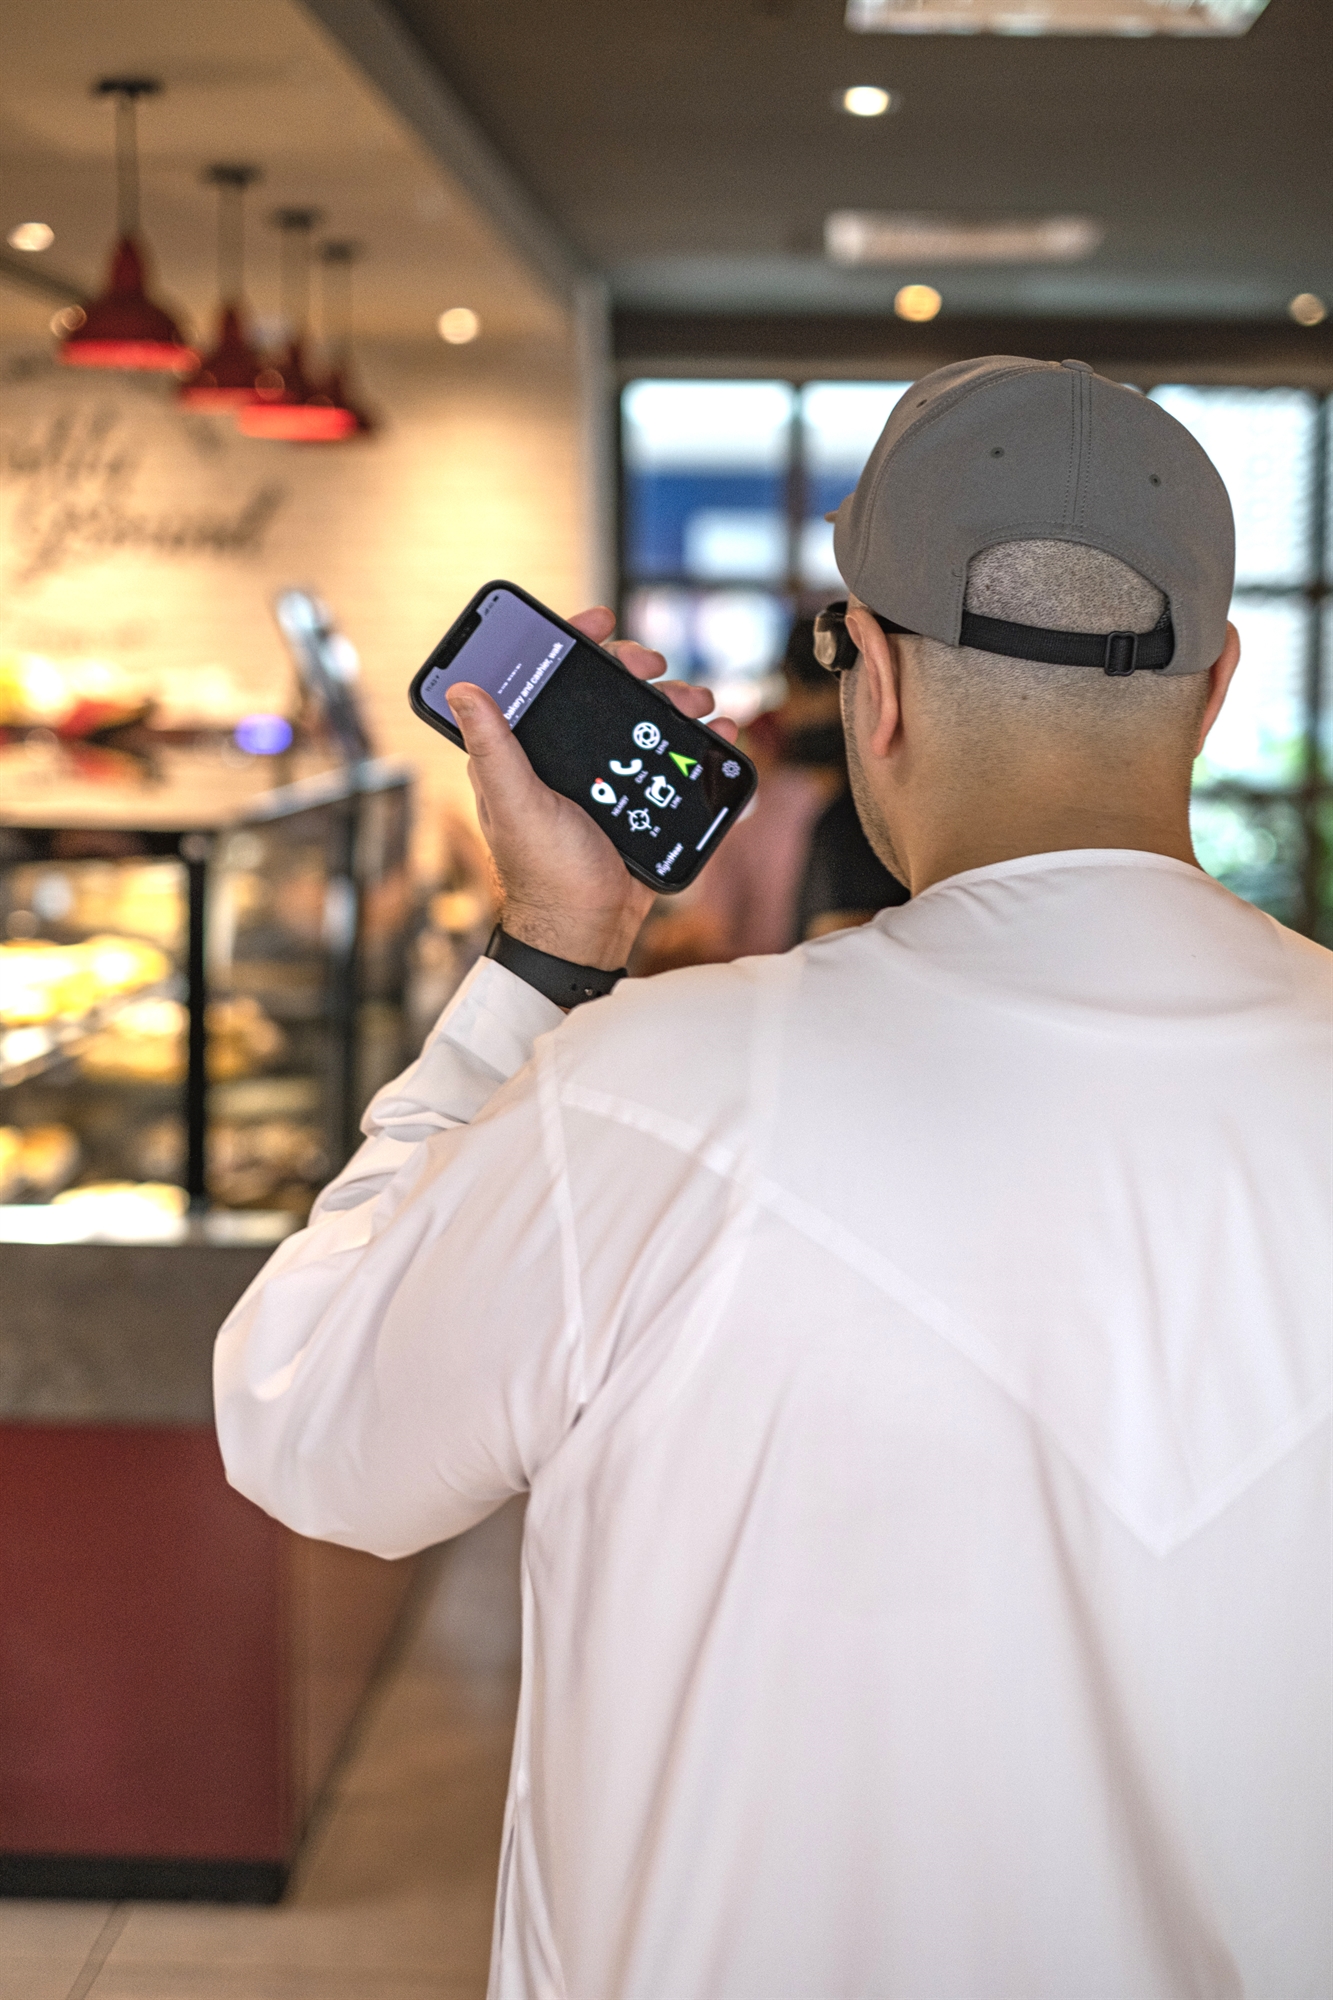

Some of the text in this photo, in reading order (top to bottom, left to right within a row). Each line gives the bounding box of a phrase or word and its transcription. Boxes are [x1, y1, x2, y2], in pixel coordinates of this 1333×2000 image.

[503, 695, 525, 720] bakery
[521, 681, 535, 698] and
[530, 658, 554, 685] cashier,
[548, 642, 564, 659] walk
[655, 739, 670, 755] LENS
[634, 770, 649, 785] CALL
[689, 763, 704, 781] WEST
[611, 794, 629, 818] NEARBY
[669, 795, 683, 810] LINK
[655, 842, 684, 876] RightHear
